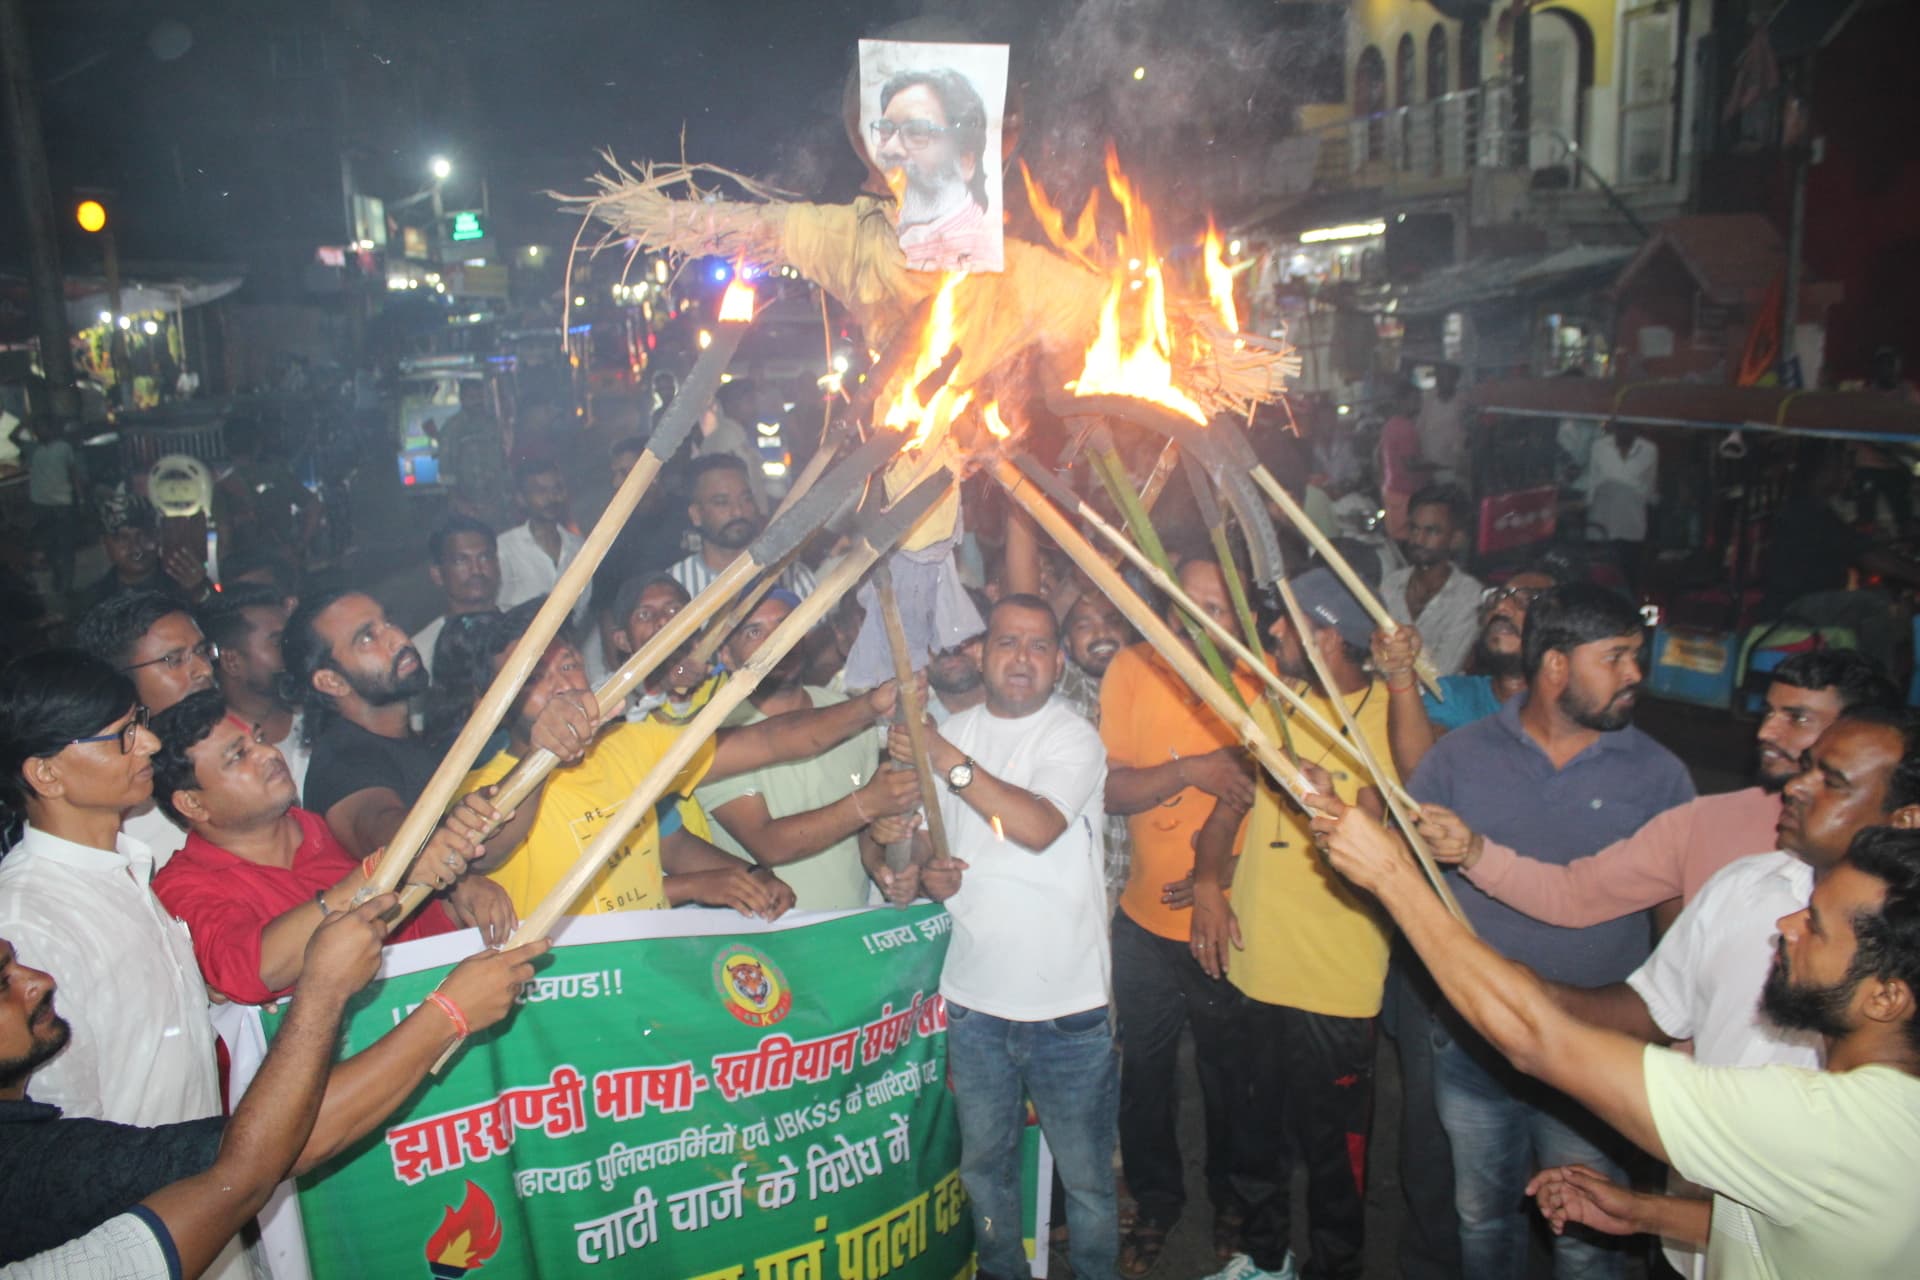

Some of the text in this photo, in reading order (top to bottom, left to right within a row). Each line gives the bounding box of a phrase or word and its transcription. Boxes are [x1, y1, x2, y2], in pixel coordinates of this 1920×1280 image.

[573, 1112, 911, 1265] लाठी चार्ज के विरोध में
[596, 1123, 738, 1193] पुलिसकर्मियों
[742, 1115, 771, 1151] एवं
[774, 1098, 841, 1142] JBKSS
[846, 1083, 865, 1115] के
[865, 1060, 921, 1108] साथियों
